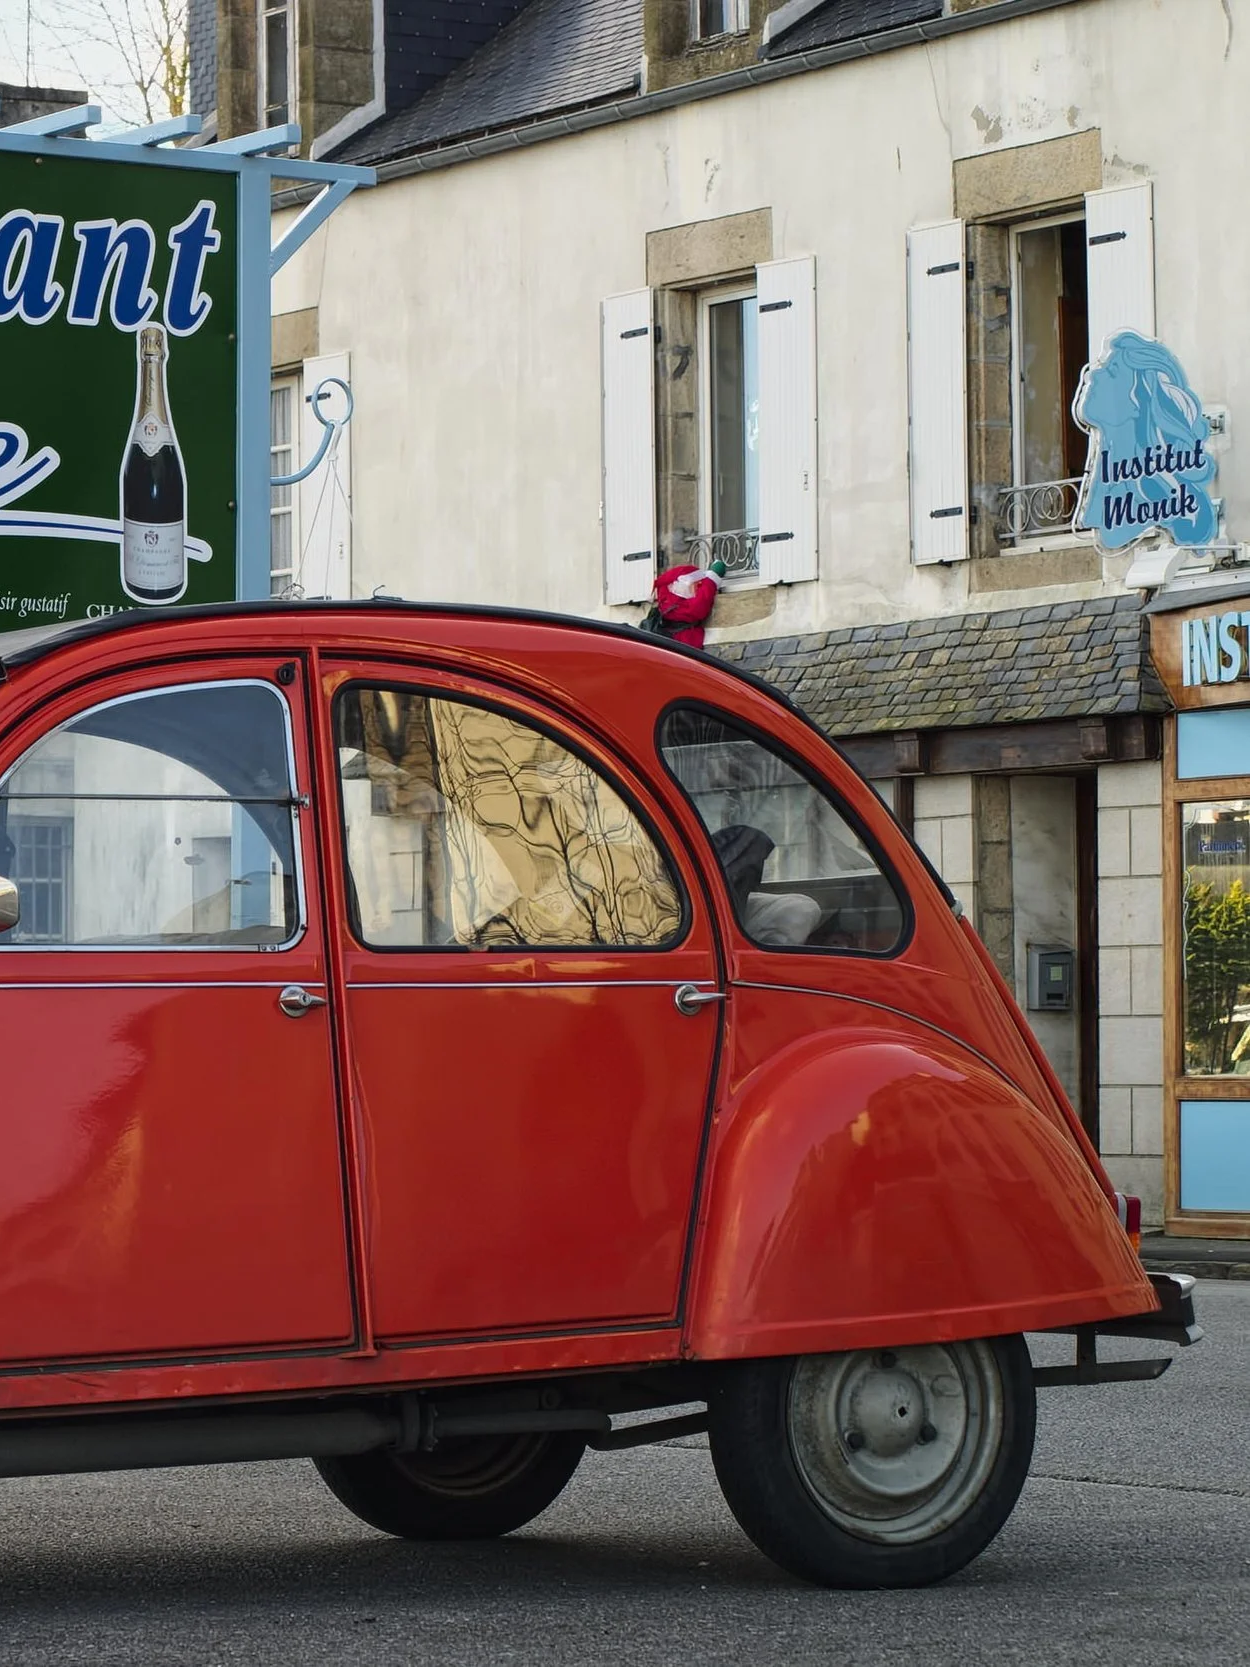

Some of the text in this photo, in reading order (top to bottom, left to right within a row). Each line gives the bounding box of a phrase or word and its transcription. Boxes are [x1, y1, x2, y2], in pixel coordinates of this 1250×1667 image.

[1101, 439, 1206, 485] Institut
[1103, 483, 1199, 531] Monik
[18, 592, 72, 618] gustatif
